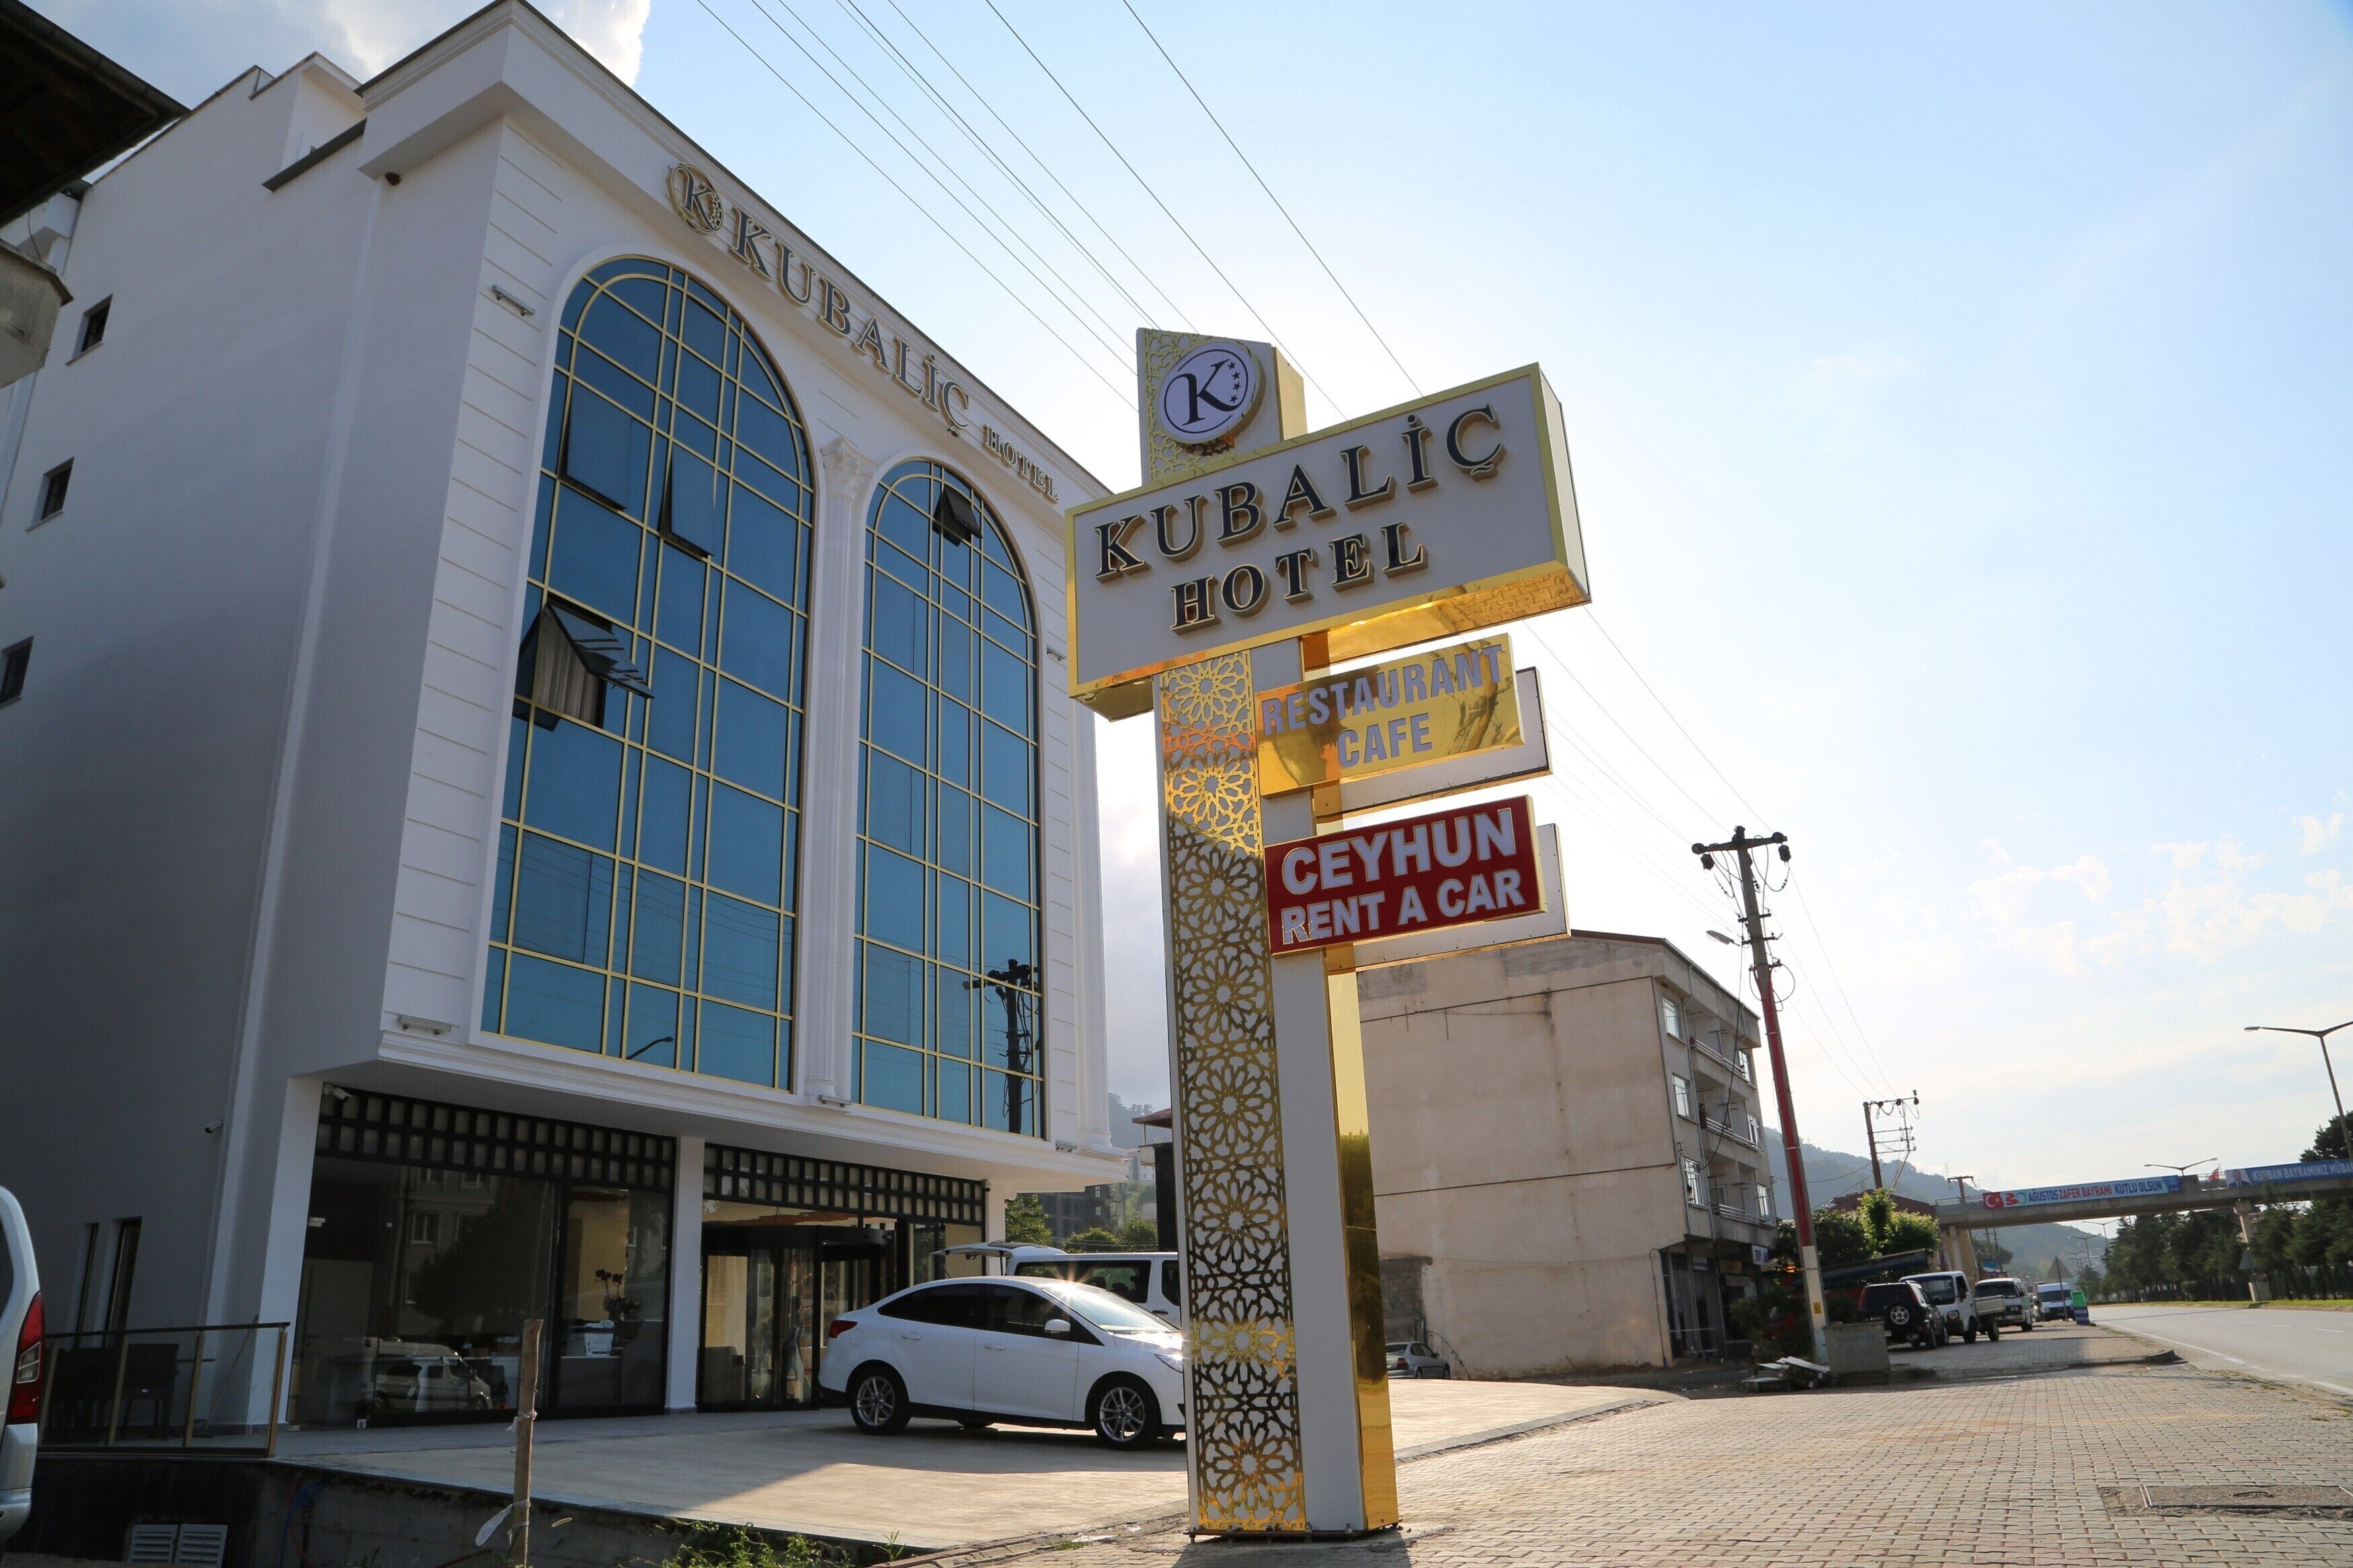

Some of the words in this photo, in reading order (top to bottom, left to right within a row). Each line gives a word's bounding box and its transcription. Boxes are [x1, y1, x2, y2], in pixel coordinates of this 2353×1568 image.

[731, 206, 969, 436] KUBALİÇ
[982, 424, 1060, 503] HOTEL
[1166, 358, 1240, 427] K
[1094, 404, 1507, 582] KUBALİÇ
[1170, 521, 1429, 634] HOTEL
[1262, 644, 1505, 737] RESTAURANT
[1338, 712, 1433, 769] CAFE
[1281, 807, 1517, 895] CEYHUN
[1281, 891, 1385, 944] RENT
[1398, 886, 1428, 925] A
[1437, 869, 1526, 917] CAR
[2028, 1188, 2059, 1202] AĞUSTOS
[2059, 1186, 2081, 1199] ZAFER
[2081, 1184, 2112, 1198] BAYRAMI
[2114, 1182, 2138, 1194] KUTLU
[2140, 1180, 2163, 1192] OLSUN
